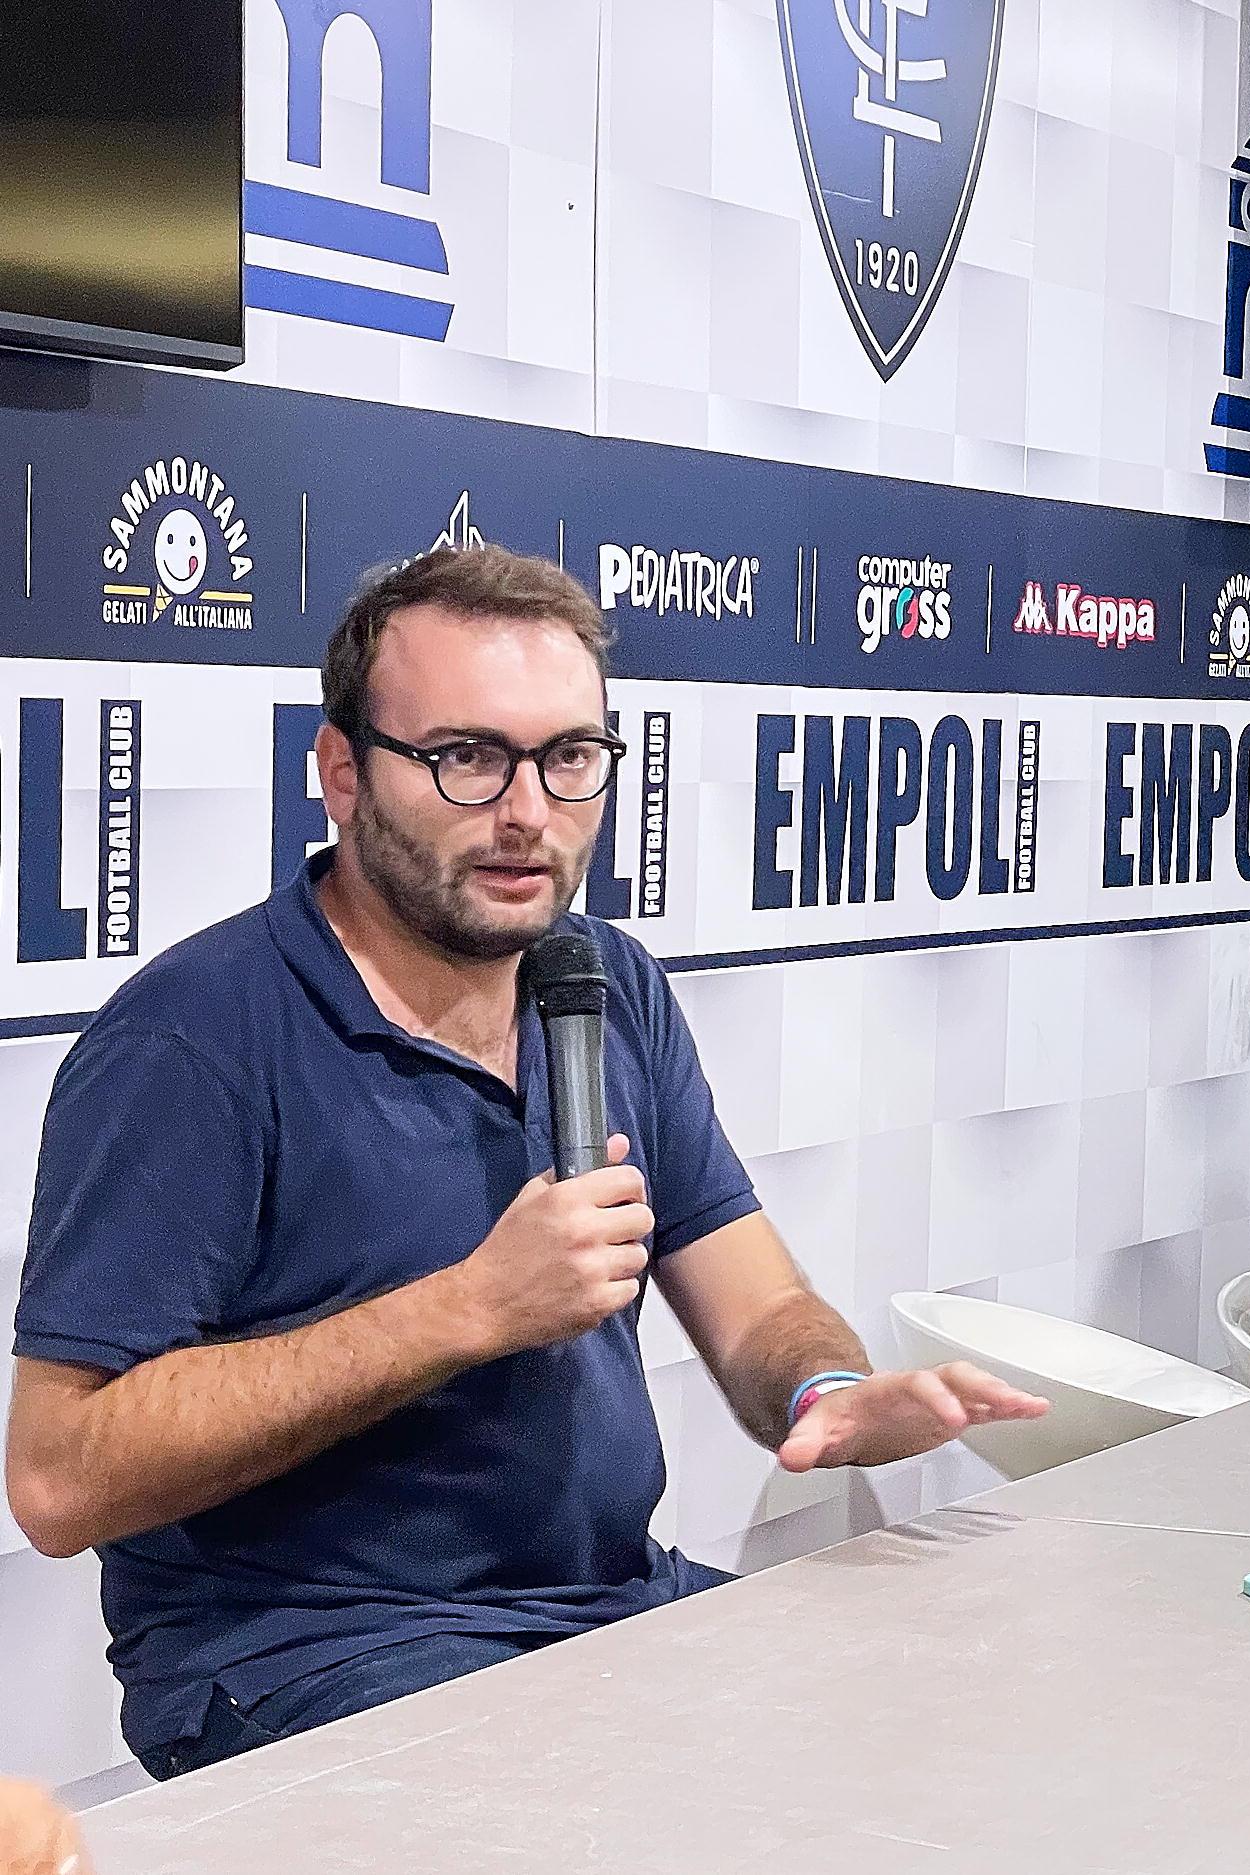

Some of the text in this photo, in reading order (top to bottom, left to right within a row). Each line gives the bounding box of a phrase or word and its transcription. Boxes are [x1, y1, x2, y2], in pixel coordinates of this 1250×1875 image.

[855, 239, 920, 296] 1920
[102, 456, 254, 582] SAMMONTANA
[857, 554, 951, 589] computer
[102, 600, 254, 630] GELATI ALL'ITALIANA
[856, 584, 952, 654] gross
[1056, 583, 1156, 648] Kappa
[107, 705, 134, 953] FOOTBALL CLUB
[644, 716, 666, 915] FOOTBALL CLUB
[1018, 724, 1037, 890] FOOTBALL CLUB
